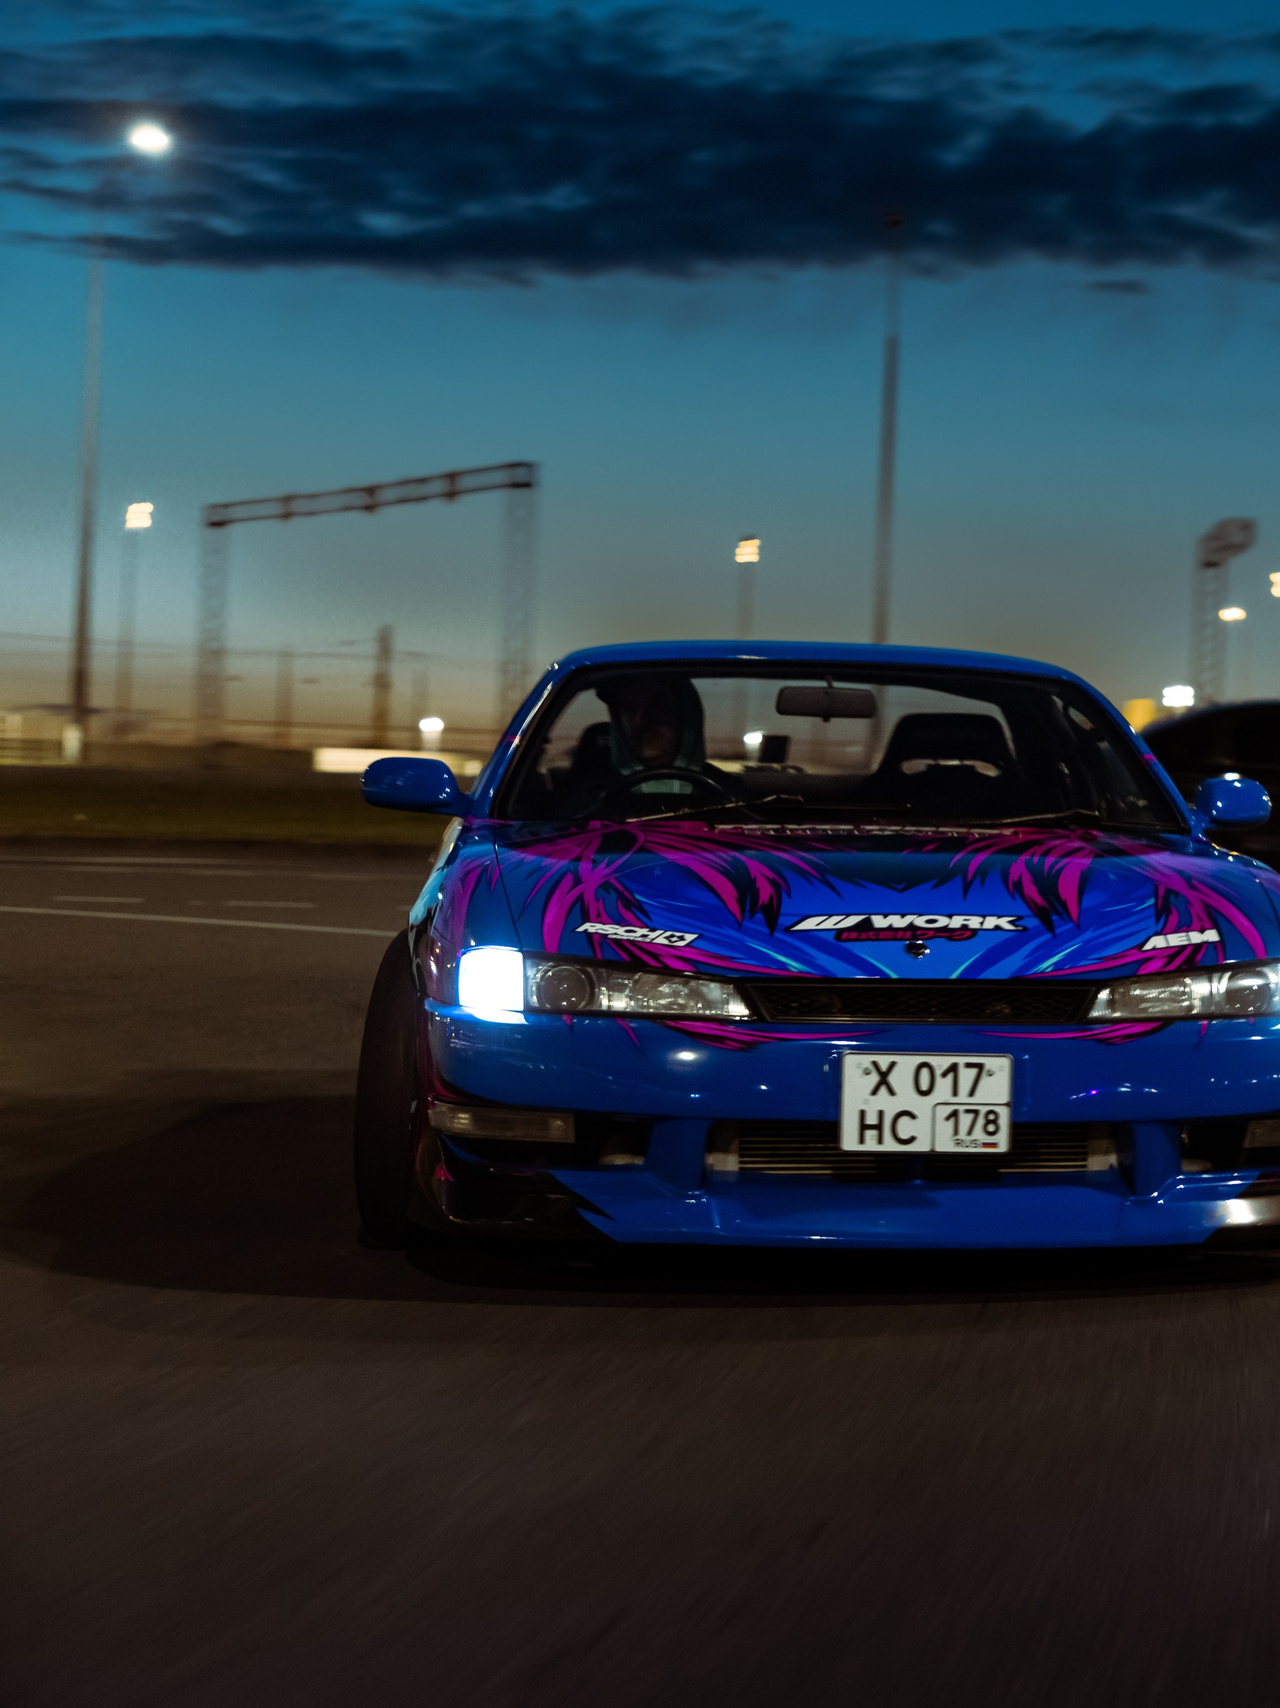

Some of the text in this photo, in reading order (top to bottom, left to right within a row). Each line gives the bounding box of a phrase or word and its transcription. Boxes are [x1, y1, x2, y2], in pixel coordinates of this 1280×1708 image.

[1141, 928, 1221, 951] AEM
[914, 1061, 985, 1098] 017
[944, 1109, 1000, 1136] 178
[953, 1138, 981, 1149] RUS
